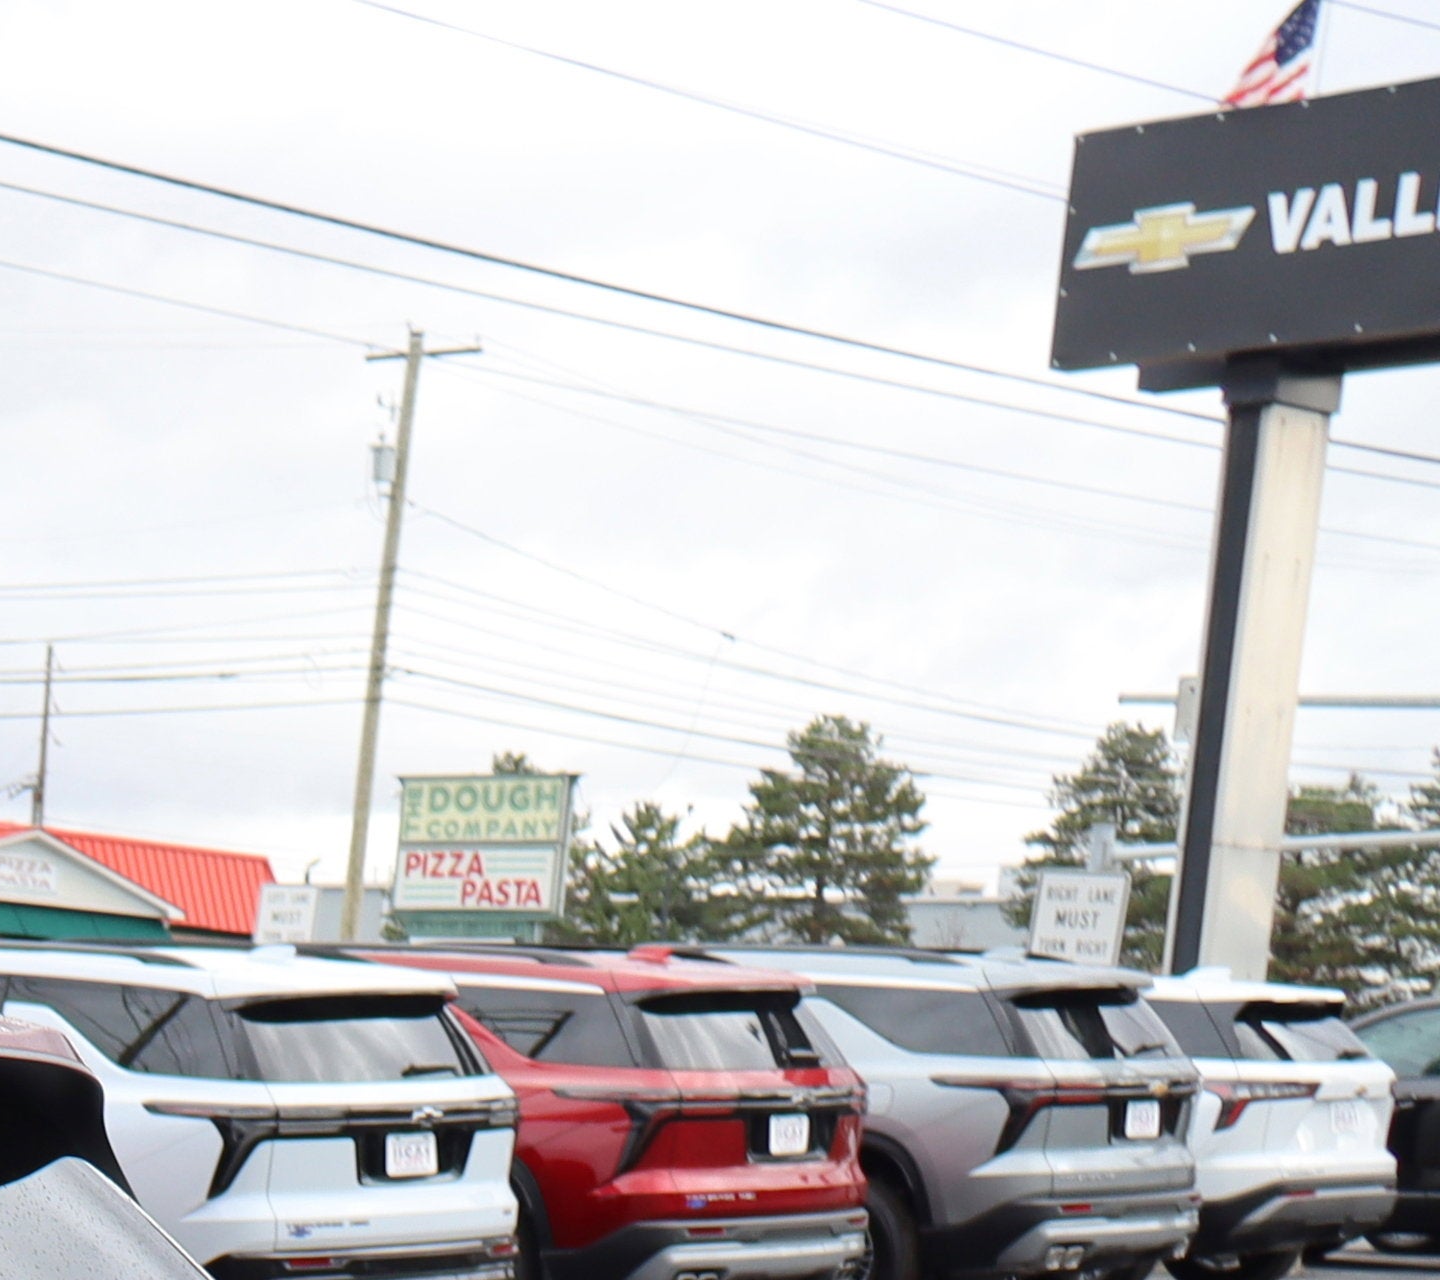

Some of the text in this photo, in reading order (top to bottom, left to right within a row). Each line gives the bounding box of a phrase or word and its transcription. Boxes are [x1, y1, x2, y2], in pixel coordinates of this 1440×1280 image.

[1268, 171, 1440, 254] VALL
[430, 784, 558, 813] DOUGH
[426, 818, 555, 839] COMPANY
[405, 850, 484, 878] PIZZA
[461, 879, 543, 907] PASTA
[1055, 907, 1100, 930] MUST
